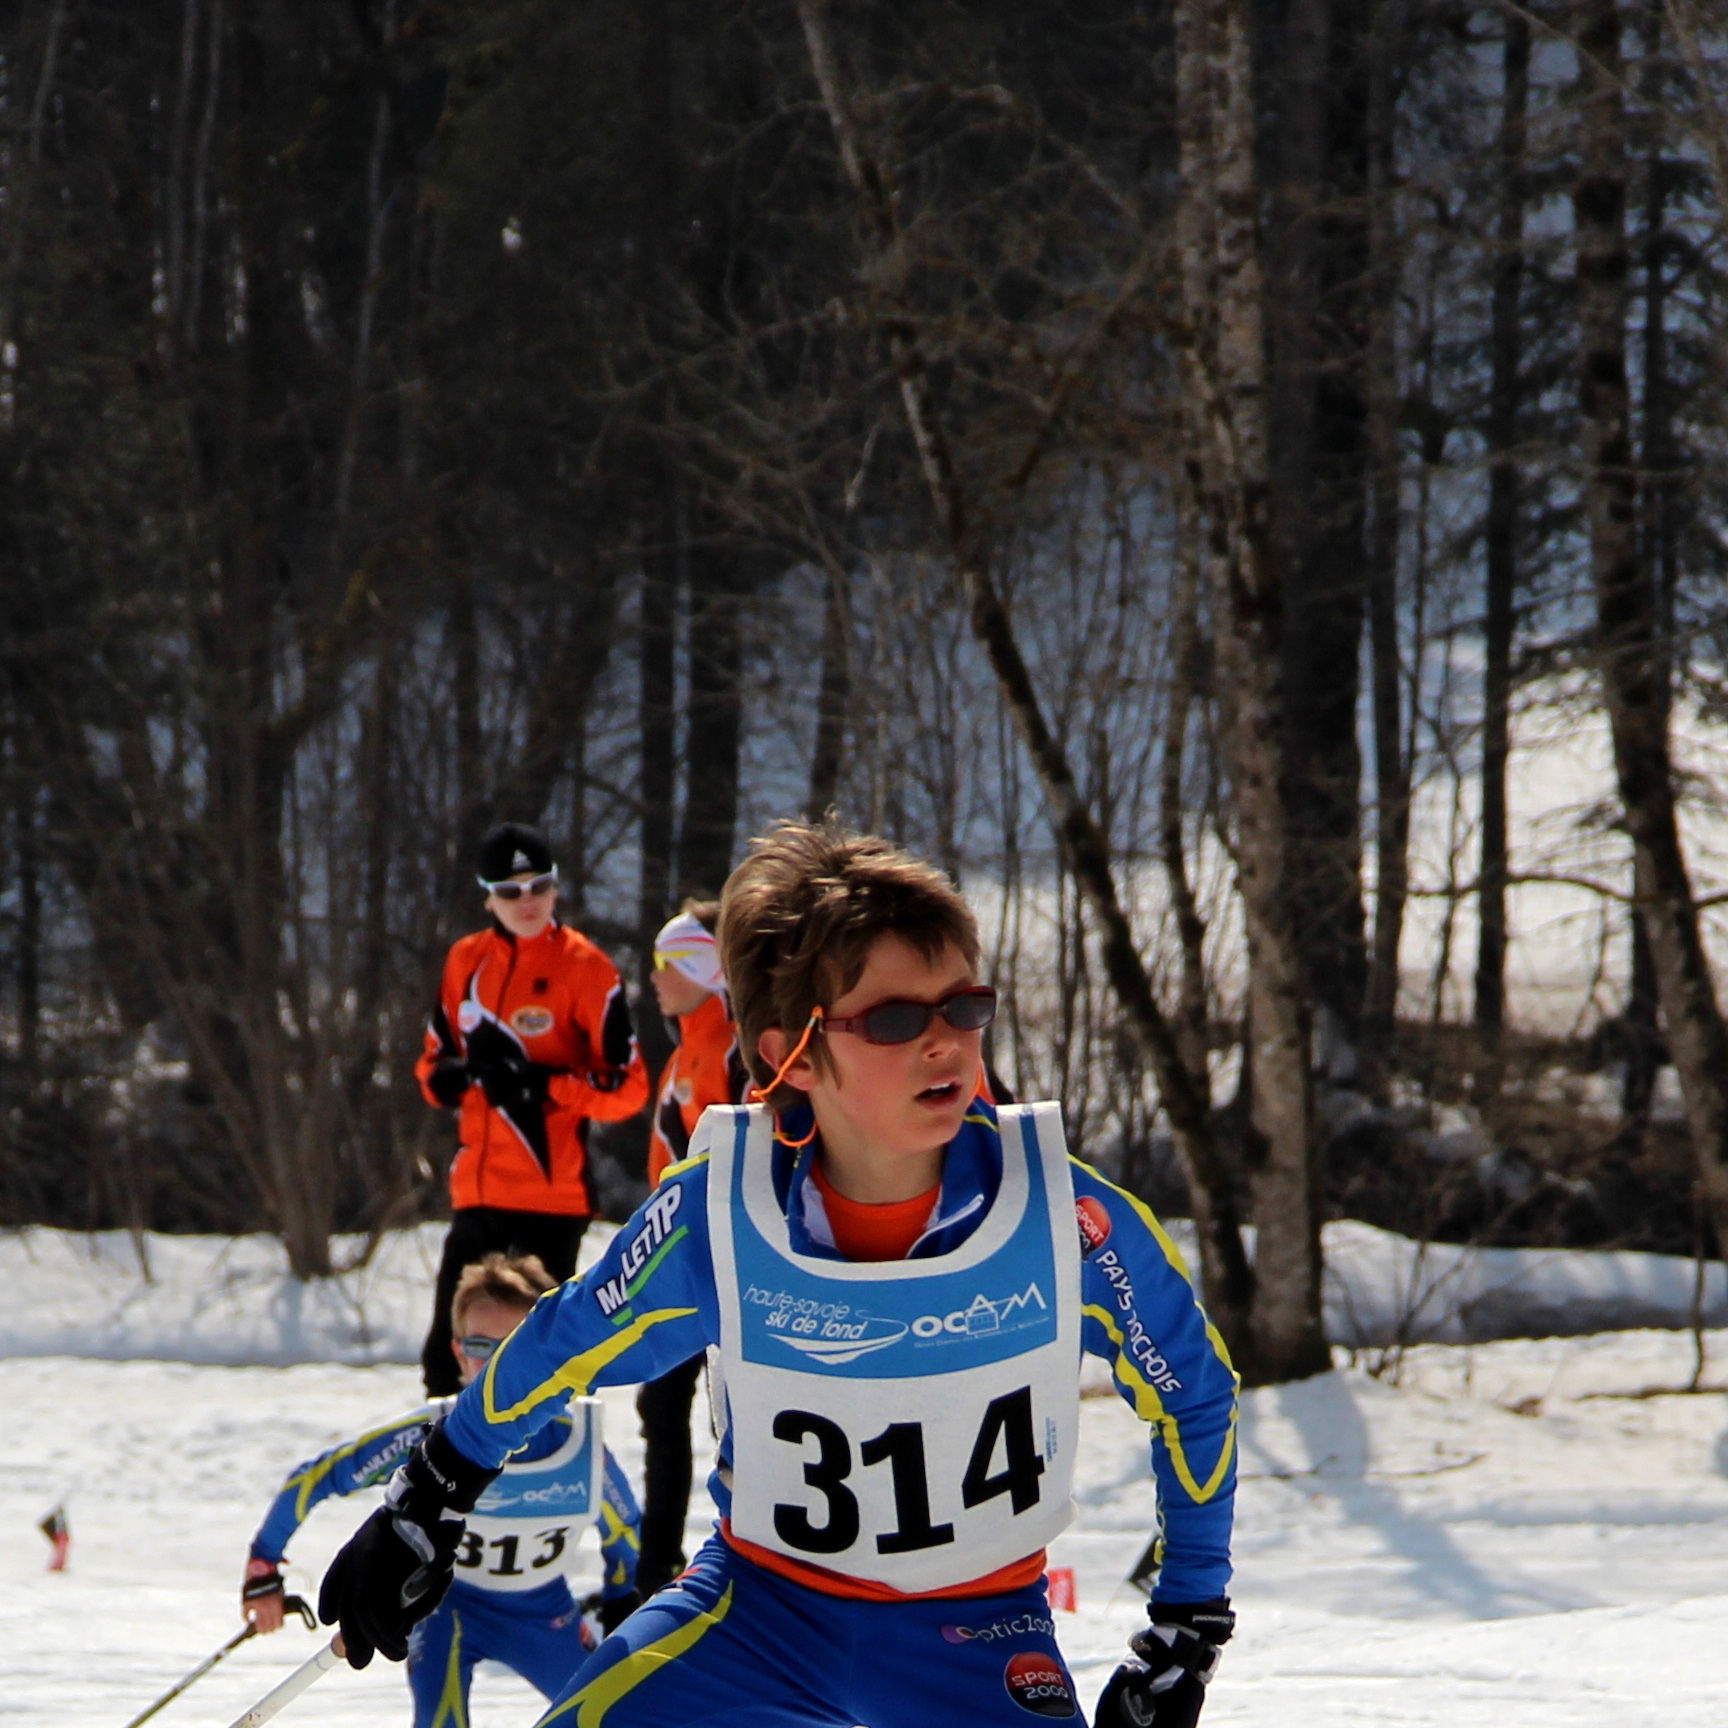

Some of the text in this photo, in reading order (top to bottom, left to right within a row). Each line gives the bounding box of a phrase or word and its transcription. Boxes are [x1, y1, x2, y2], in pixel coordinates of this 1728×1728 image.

[1096, 1250, 1135, 1311] PAYS
[743, 1283, 851, 1320] haute-savoie
[765, 1308, 868, 1340] ski de fond
[773, 1385, 1045, 1554] 314
[1012, 1671, 1063, 1687] SPORT
[1024, 1685, 1069, 1699] 2000
